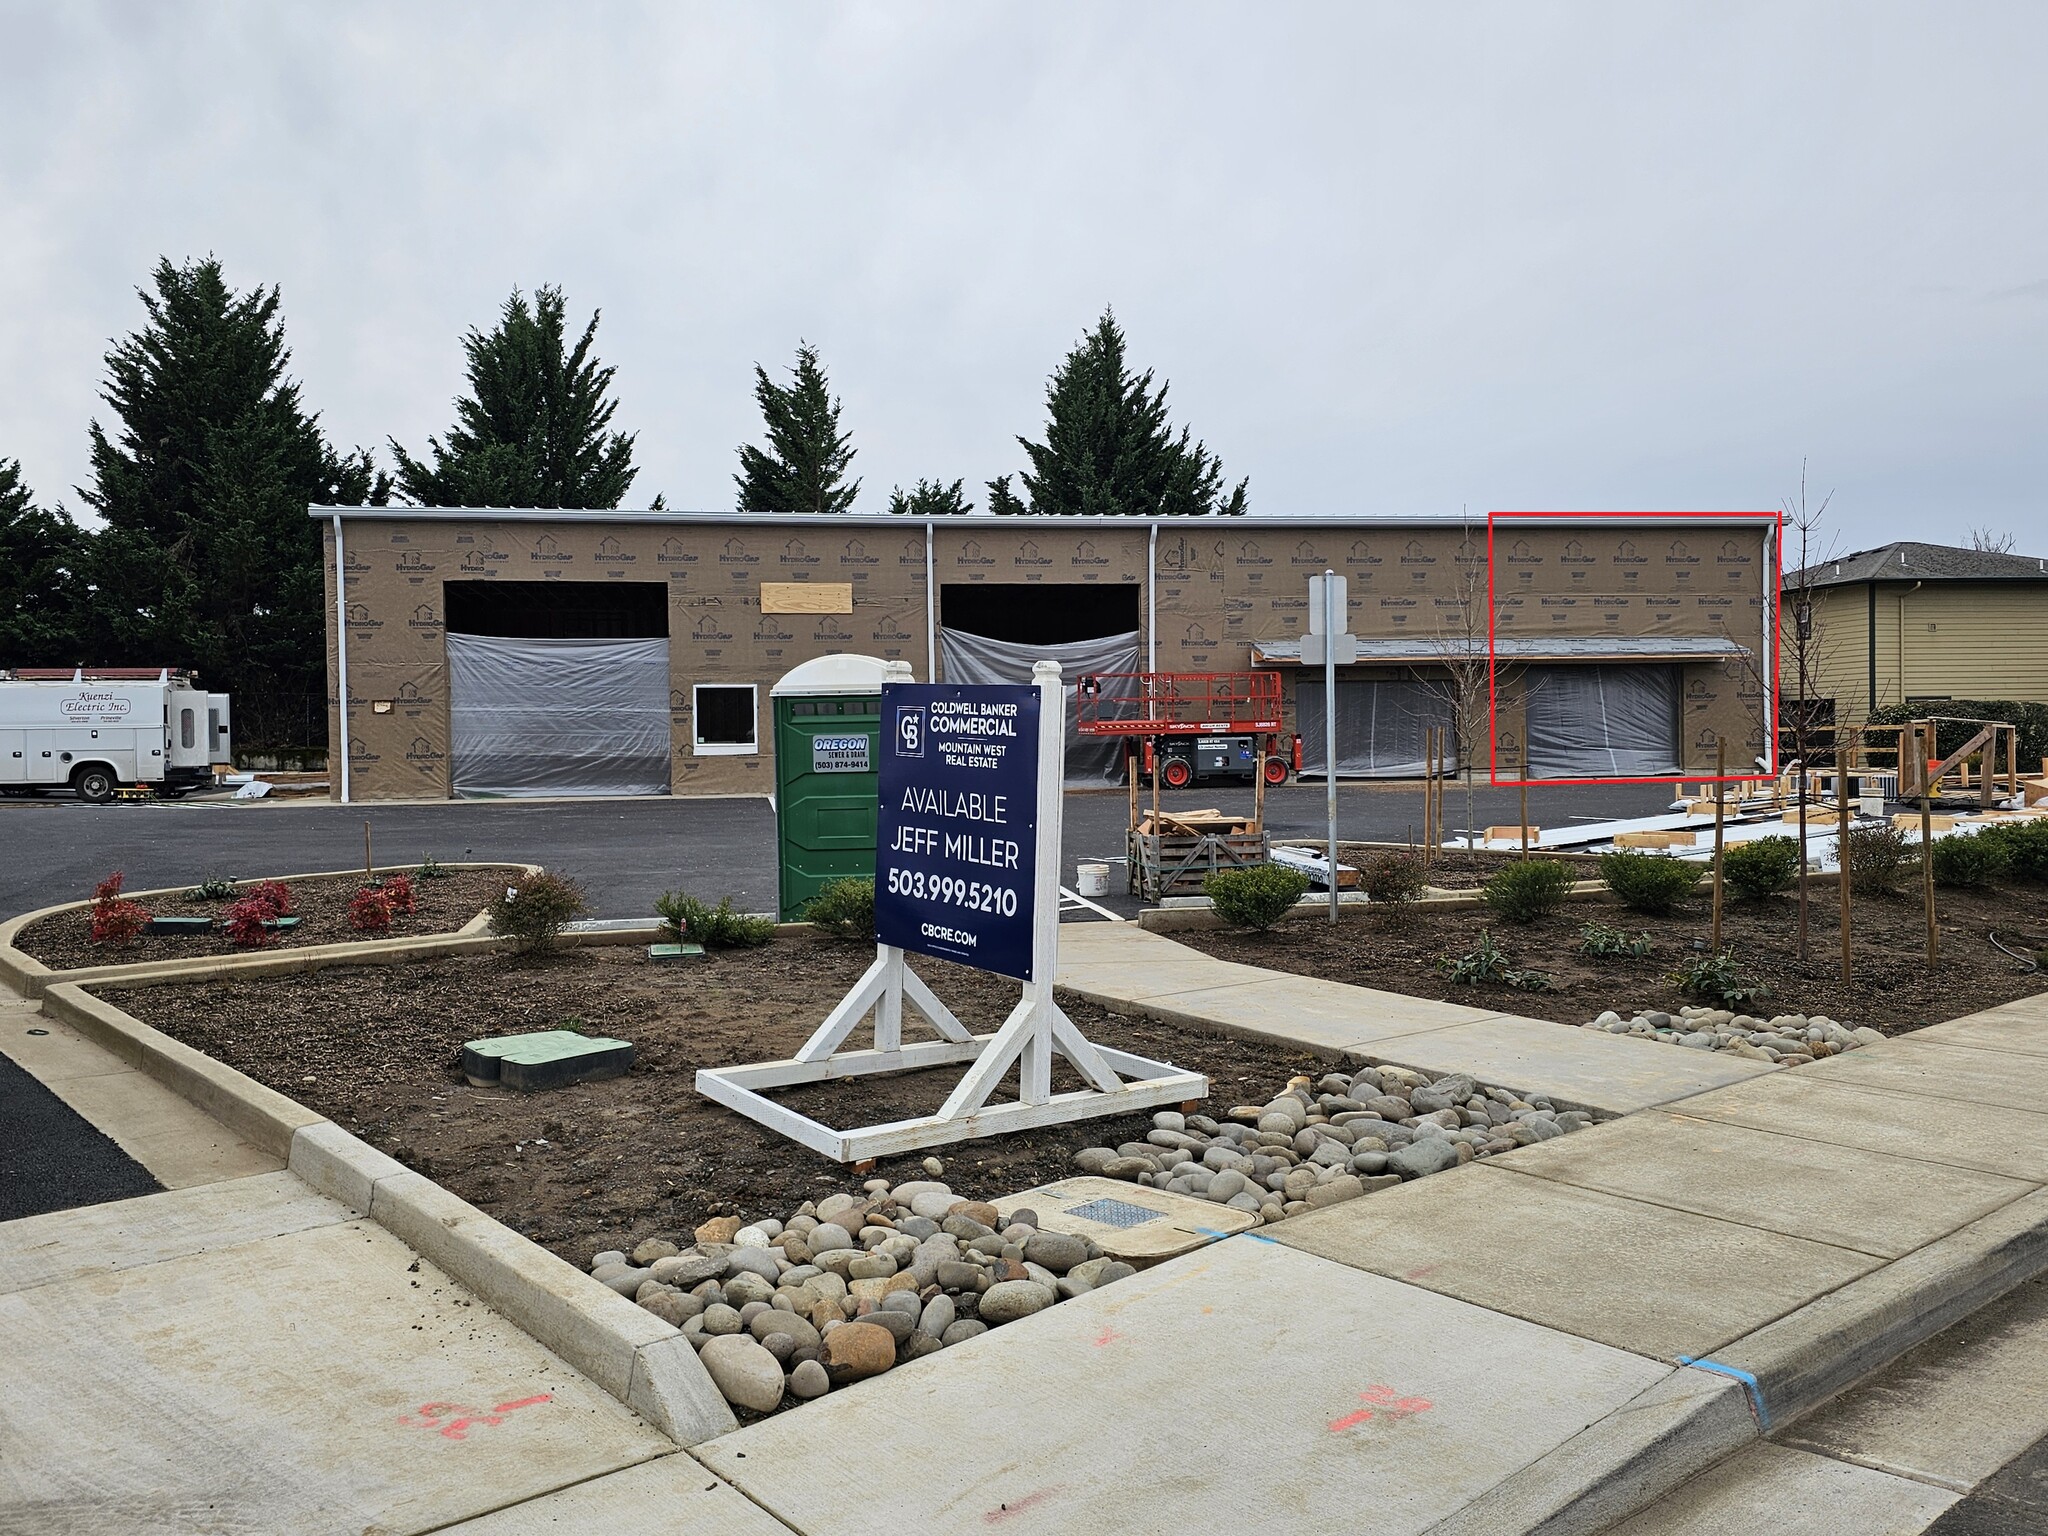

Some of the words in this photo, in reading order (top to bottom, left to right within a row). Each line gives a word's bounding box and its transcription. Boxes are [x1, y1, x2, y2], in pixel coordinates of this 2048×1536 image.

[79, 691, 113, 702] Kuenzi
[66, 702, 105, 711] Electric
[108, 702, 127, 711] Inc.
[931, 702, 979, 716] COLDWELL
[981, 703, 1017, 717] BANKER
[930, 716, 1017, 737] COMMERCIAL
[814, 738, 867, 751] OREGON
[938, 742, 982, 755] MOUNTAIN
[984, 744, 1006, 756] WEST
[828, 751, 845, 759] SEWER
[815, 762, 833, 770] (503)
[834, 761, 868, 769] 874-9414
[945, 756, 967, 767] REAL
[968, 757, 998, 769] ESTATE
[901, 786, 1007, 824] AVAILABLE
[890, 825, 939, 856] JEFF
[945, 832, 1019, 870] MILLER
[887, 867, 1018, 917] 503.999.5210
[921, 922, 977, 947] CBCRE.COM
